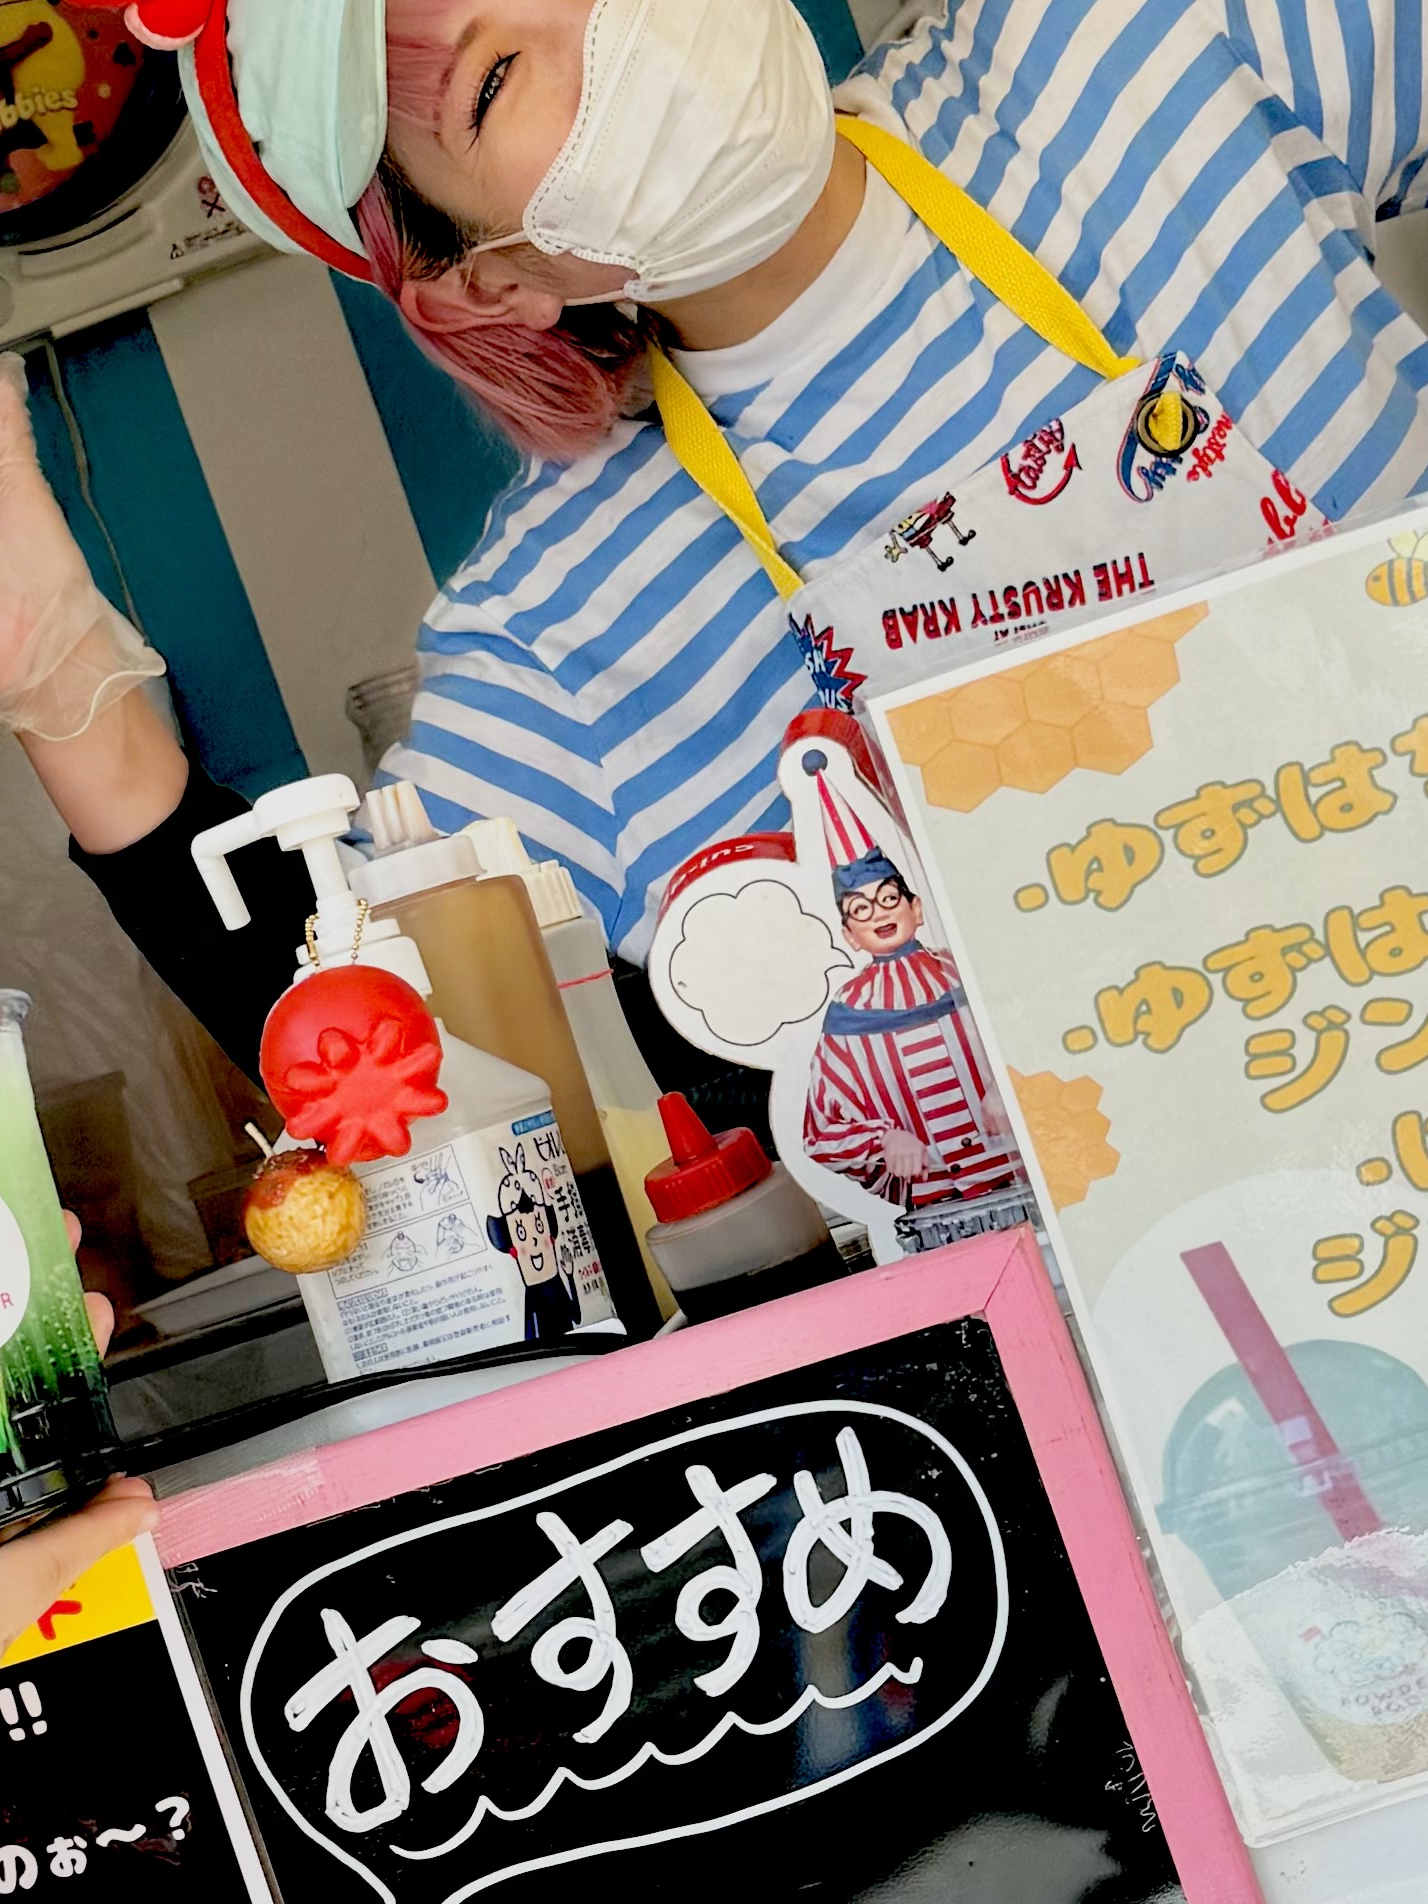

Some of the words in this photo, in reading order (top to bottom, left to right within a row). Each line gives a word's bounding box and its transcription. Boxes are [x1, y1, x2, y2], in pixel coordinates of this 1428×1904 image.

[971, 563, 1089, 628] KRUSTY
[1098, 553, 1155, 603] THE
[882, 597, 962, 651] KRAB
[286, 1428, 952, 1834] おすすめ
